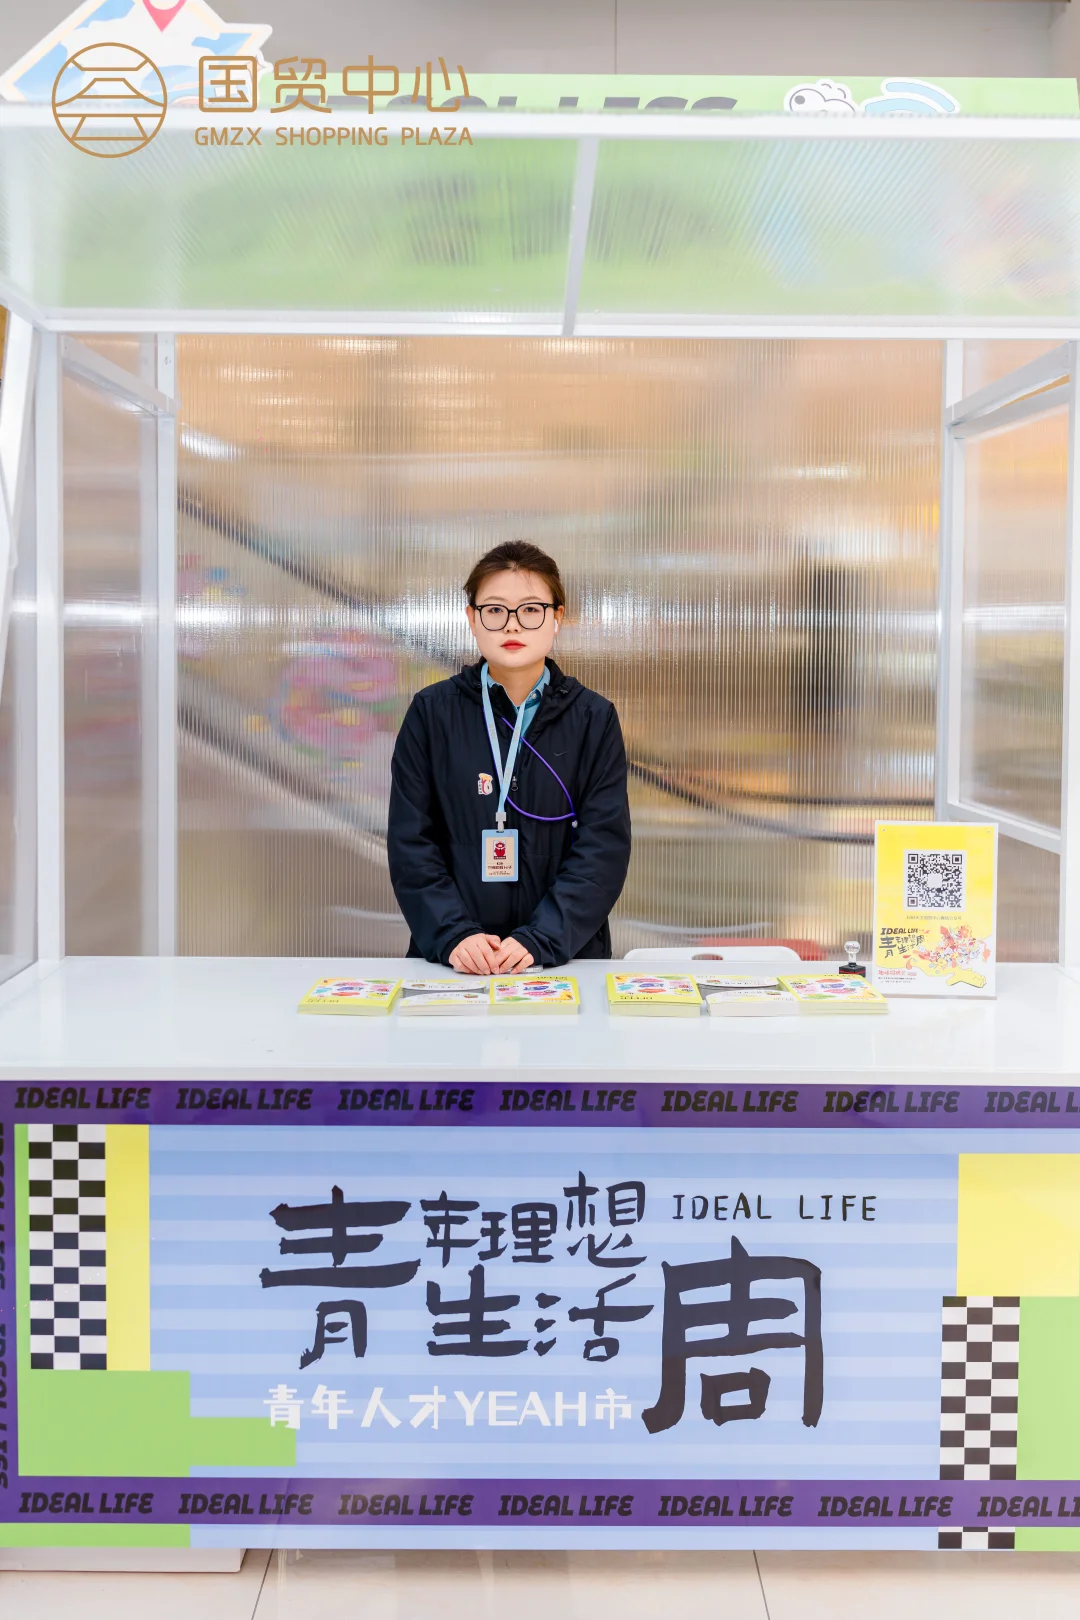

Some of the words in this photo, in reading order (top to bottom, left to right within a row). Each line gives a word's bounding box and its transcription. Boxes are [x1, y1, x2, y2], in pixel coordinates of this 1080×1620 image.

[880, 927, 907, 936] IDEAL
[14, 1086, 91, 1110] IDEAL
[95, 1087, 152, 1110] LIFE
[175, 1088, 252, 1110] IDEAL
[257, 1088, 313, 1110] LIFE
[337, 1088, 414, 1111] IDEAL
[419, 1088, 476, 1112] LIFE
[499, 1089, 576, 1112] IDEAL
[581, 1089, 637, 1112] LIFE
[661, 1090, 738, 1112] IDEAL
[743, 1090, 799, 1113] LIFE
[823, 1091, 899, 1113] IDEAL
[905, 1091, 960, 1113] LIFE
[985, 1091, 1060, 1113] IDEAL
[673, 1193, 772, 1220] IDEAL
[799, 1194, 877, 1221] LIFE
[19, 1492, 94, 1514] IDEAL
[99, 1492, 154, 1514] LIFE
[178, 1493, 254, 1515] IDEAL
[259, 1494, 314, 1515] LIFE
[338, 1494, 413, 1516] IDEAL
[419, 1494, 474, 1516] LIFE
[498, 1495, 573, 1516] IDEAL
[579, 1495, 634, 1517] LIFE
[658, 1495, 733, 1517] IDEAL
[739, 1495, 794, 1517] LIFE
[818, 1496, 893, 1517] IDEAL
[898, 1496, 953, 1518] LIFE
[978, 1496, 1052, 1518] IDEAL
